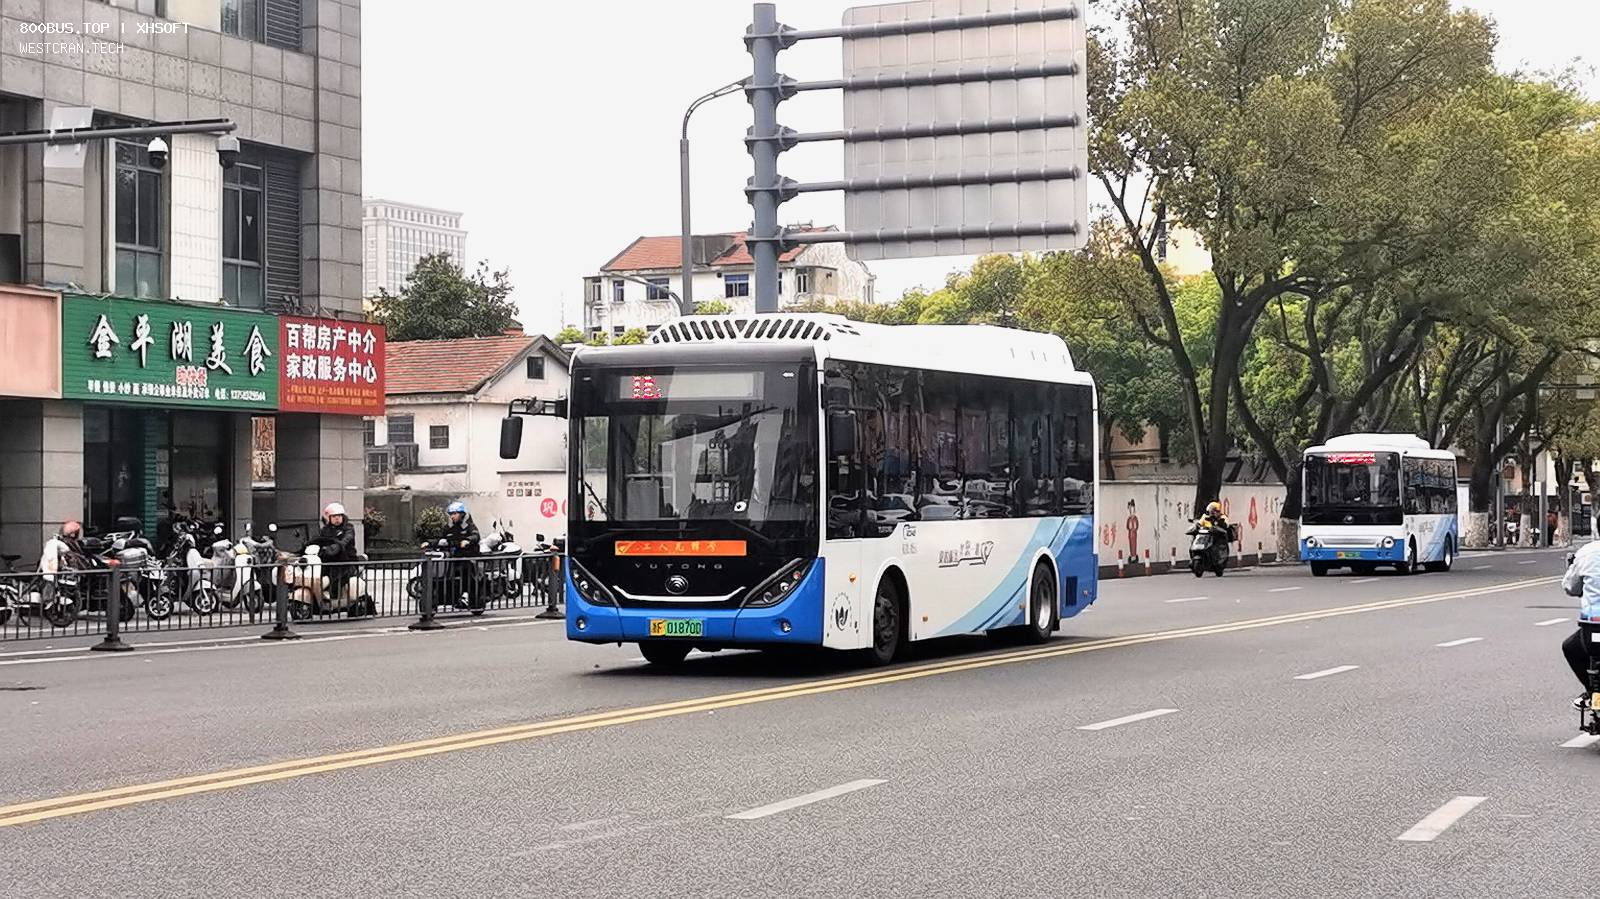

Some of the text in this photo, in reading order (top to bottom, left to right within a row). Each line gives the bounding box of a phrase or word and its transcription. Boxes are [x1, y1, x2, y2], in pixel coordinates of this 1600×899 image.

[89, 313, 272, 376] 金平湖美食
[285, 322, 377, 354] 百帮房产中介
[286, 352, 377, 383] 家政服务中心
